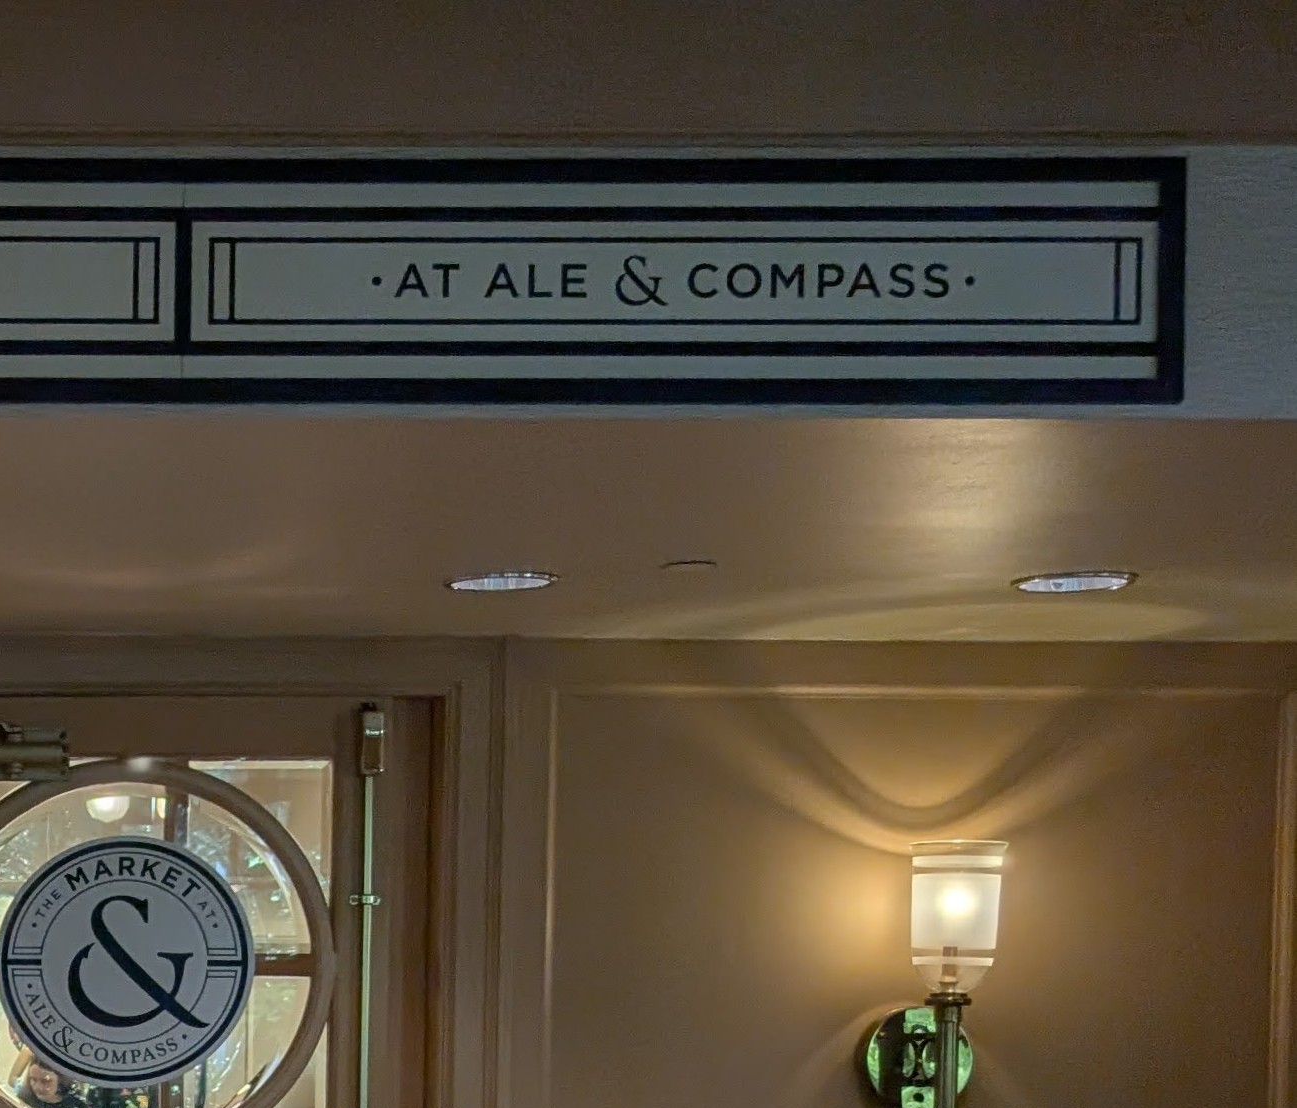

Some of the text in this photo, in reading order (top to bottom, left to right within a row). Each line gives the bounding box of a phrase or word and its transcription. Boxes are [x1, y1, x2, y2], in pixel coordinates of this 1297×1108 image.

[393, 254, 951, 307] AT ALE & COMPASS
[35, 856, 216, 921] THE MARKET AT
[67, 894, 210, 1029] &
[24, 991, 179, 1065] ALE & COMPASS
